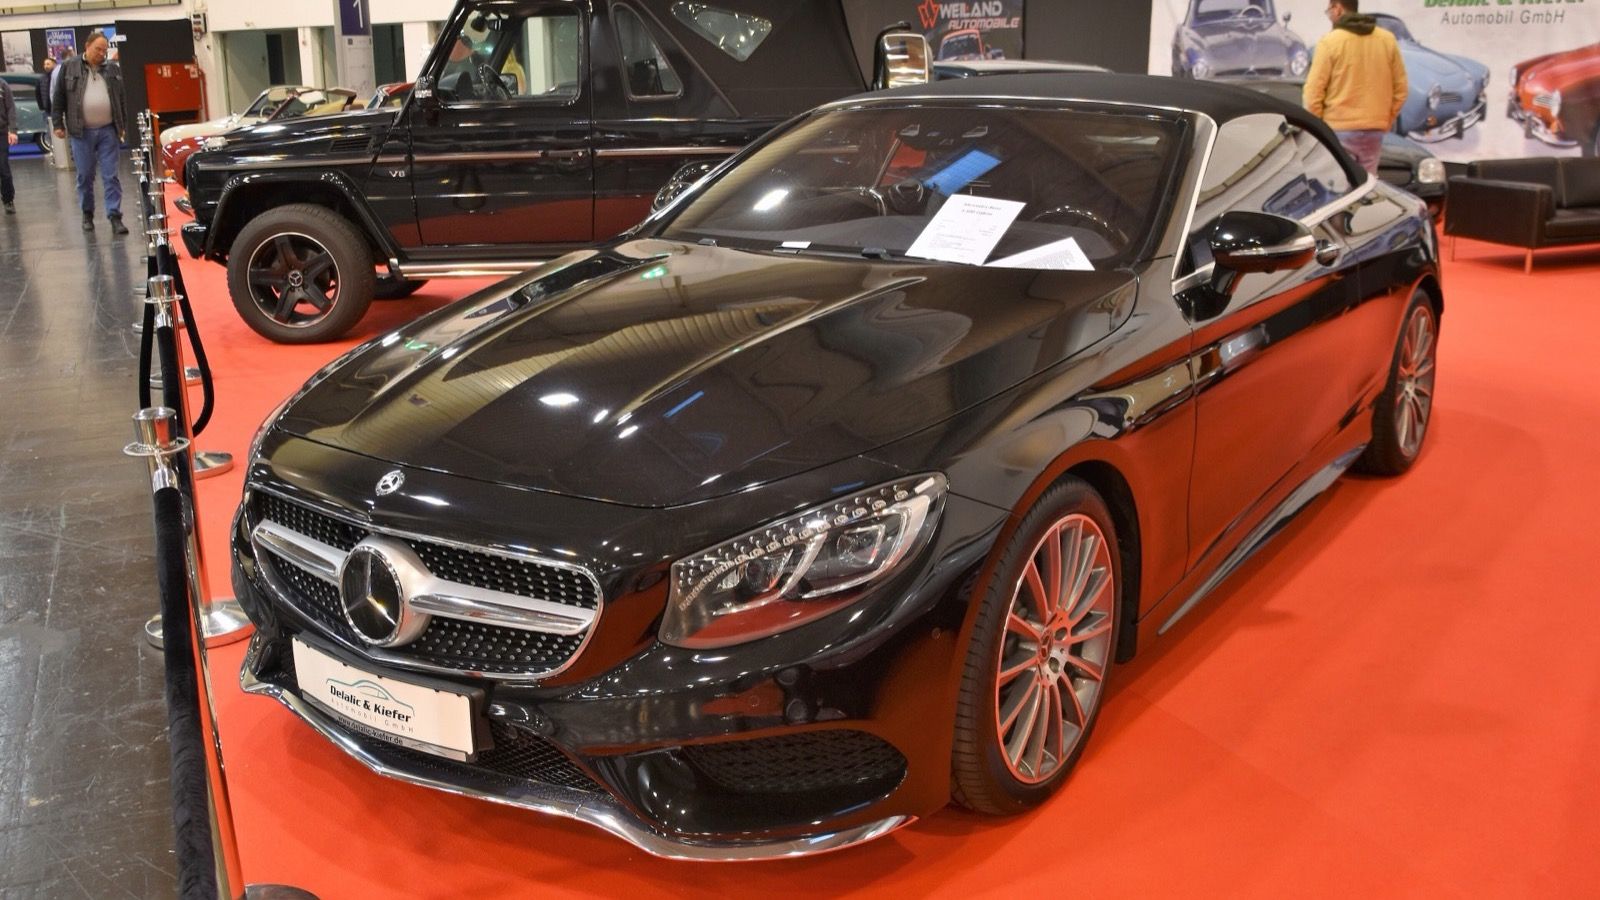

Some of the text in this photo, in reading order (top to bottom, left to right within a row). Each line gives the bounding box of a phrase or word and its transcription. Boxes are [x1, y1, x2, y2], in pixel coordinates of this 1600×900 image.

[940, 1, 1003, 19] WEILAND
[1441, 9, 1565, 25] Automobil GmbH
[948, 17, 1020, 30] AUTOMOBILE
[330, 685, 412, 722] Delalic & Kiefer
